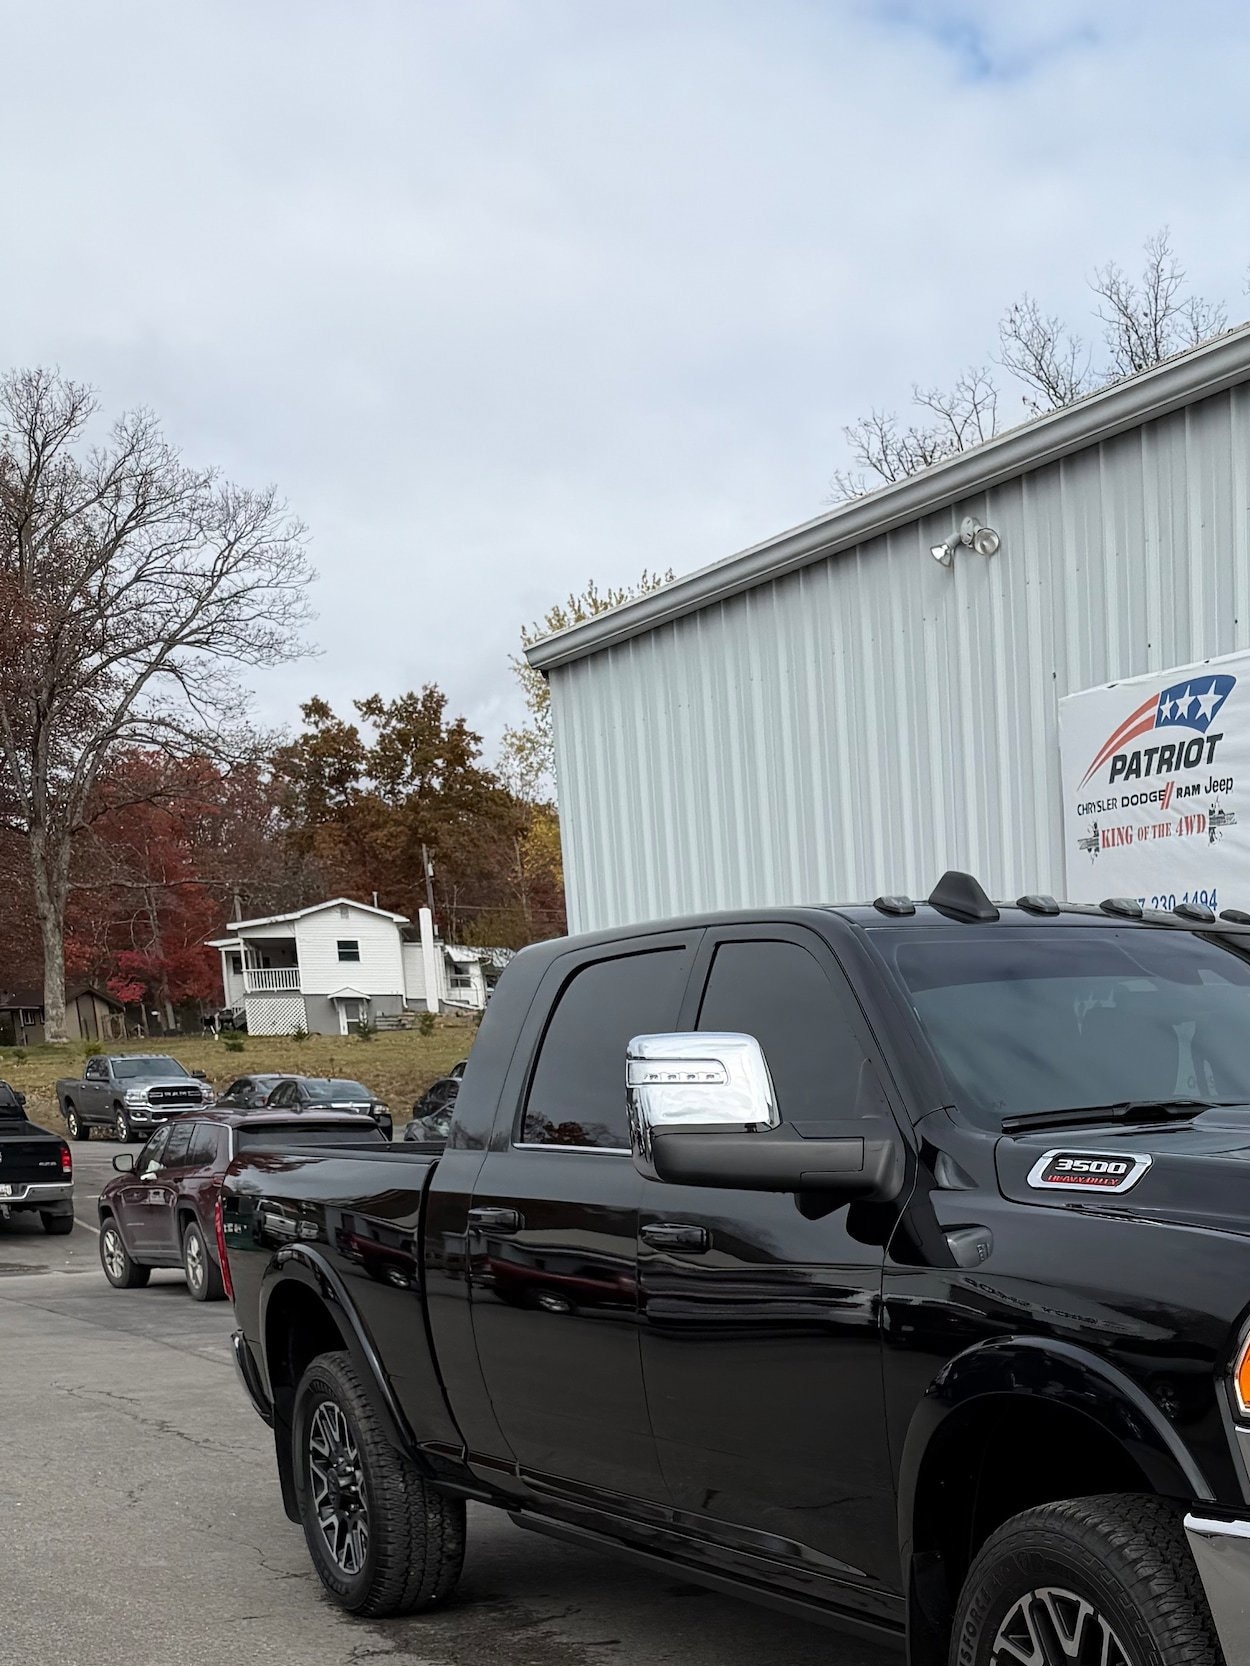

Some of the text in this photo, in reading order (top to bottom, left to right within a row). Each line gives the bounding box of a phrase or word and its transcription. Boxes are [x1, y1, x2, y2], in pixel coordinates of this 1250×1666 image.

[1108, 732, 1224, 785] PATRIOT
[1076, 775, 1234, 817] CHRYSLER DODGE RAM Jeep
[1101, 814, 1206, 849] KING OF THE 4WD
[1055, 1159, 1127, 1174] 3500
